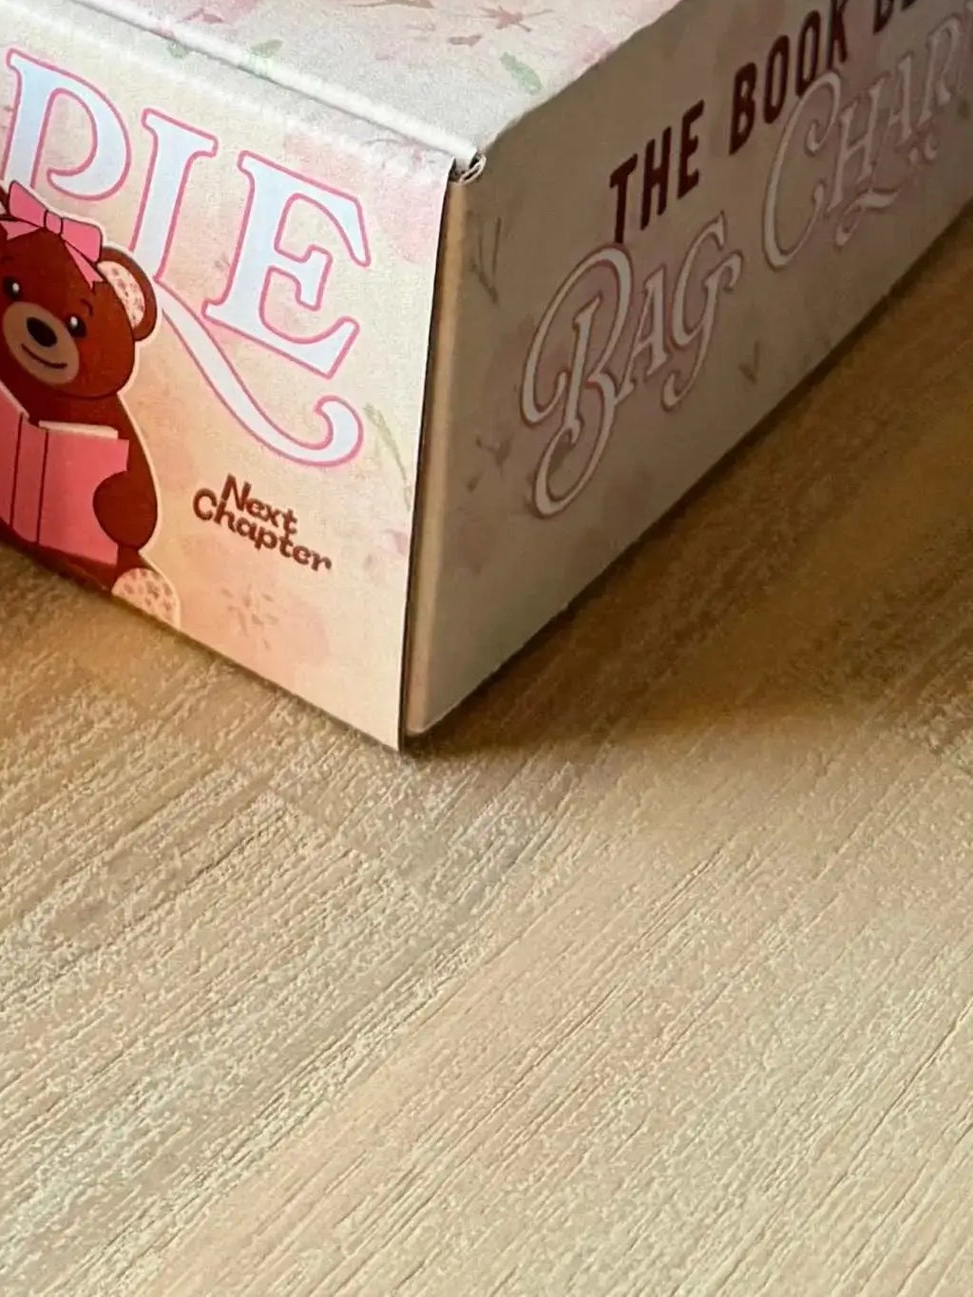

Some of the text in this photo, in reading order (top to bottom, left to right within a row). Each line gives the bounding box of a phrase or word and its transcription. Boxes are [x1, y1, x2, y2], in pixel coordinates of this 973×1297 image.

[609, 99, 705, 244] THE
[520, 211, 744, 519] BAG
[192, 488, 332, 572] Chapter
[220, 473, 298, 535] Next
